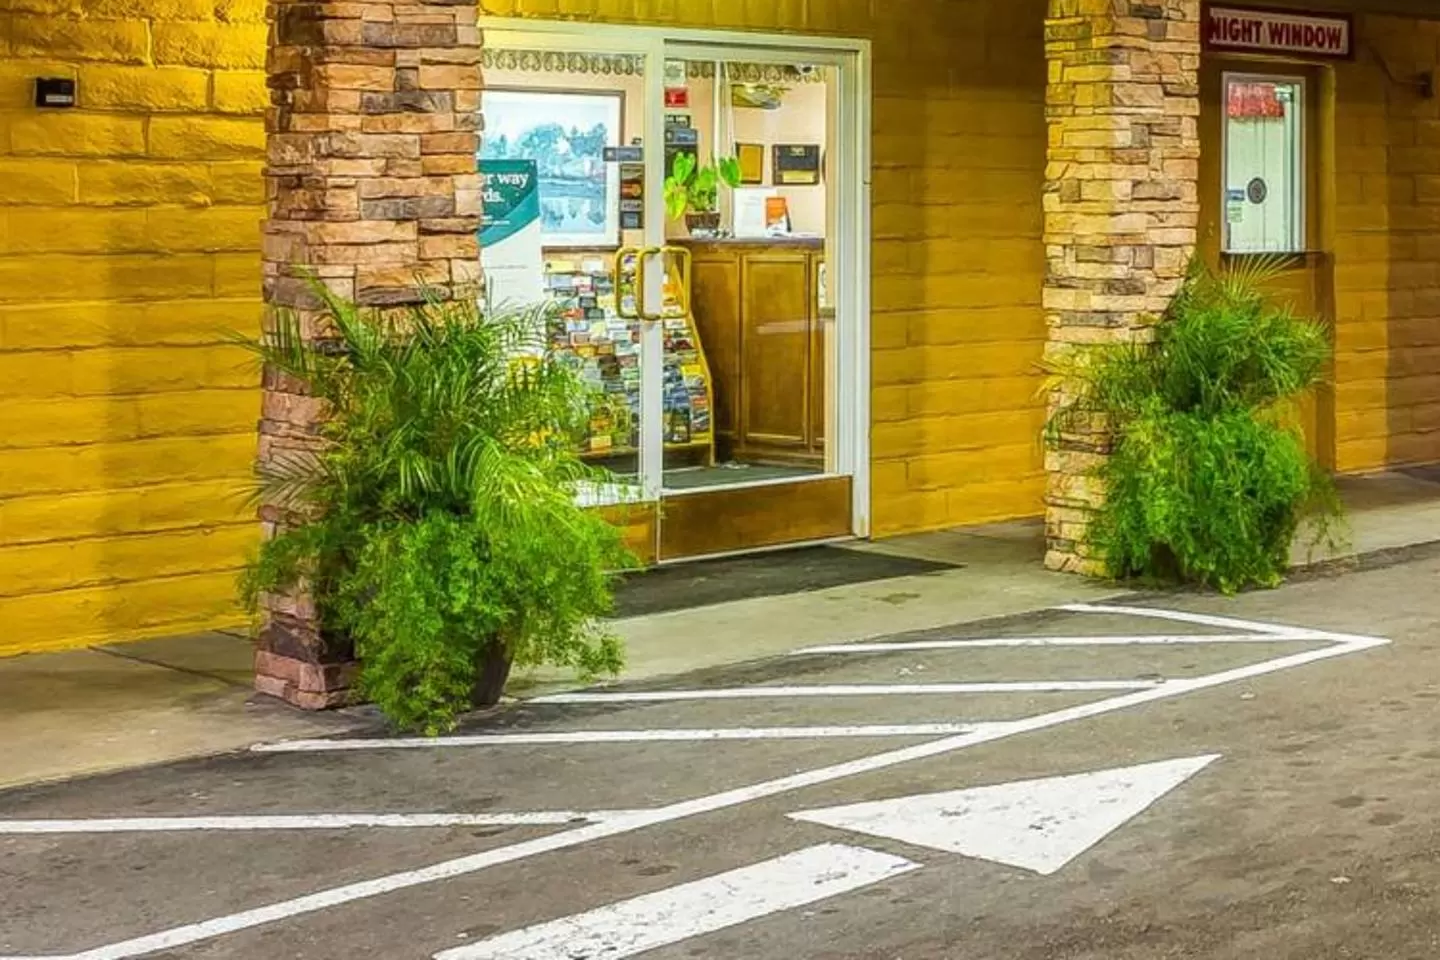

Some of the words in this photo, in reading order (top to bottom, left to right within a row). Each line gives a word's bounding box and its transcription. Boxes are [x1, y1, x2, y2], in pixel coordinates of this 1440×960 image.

[1209, 16, 1262, 43] NIGHT
[1267, 21, 1342, 49] WINDOW
[496, 173, 529, 189] way
